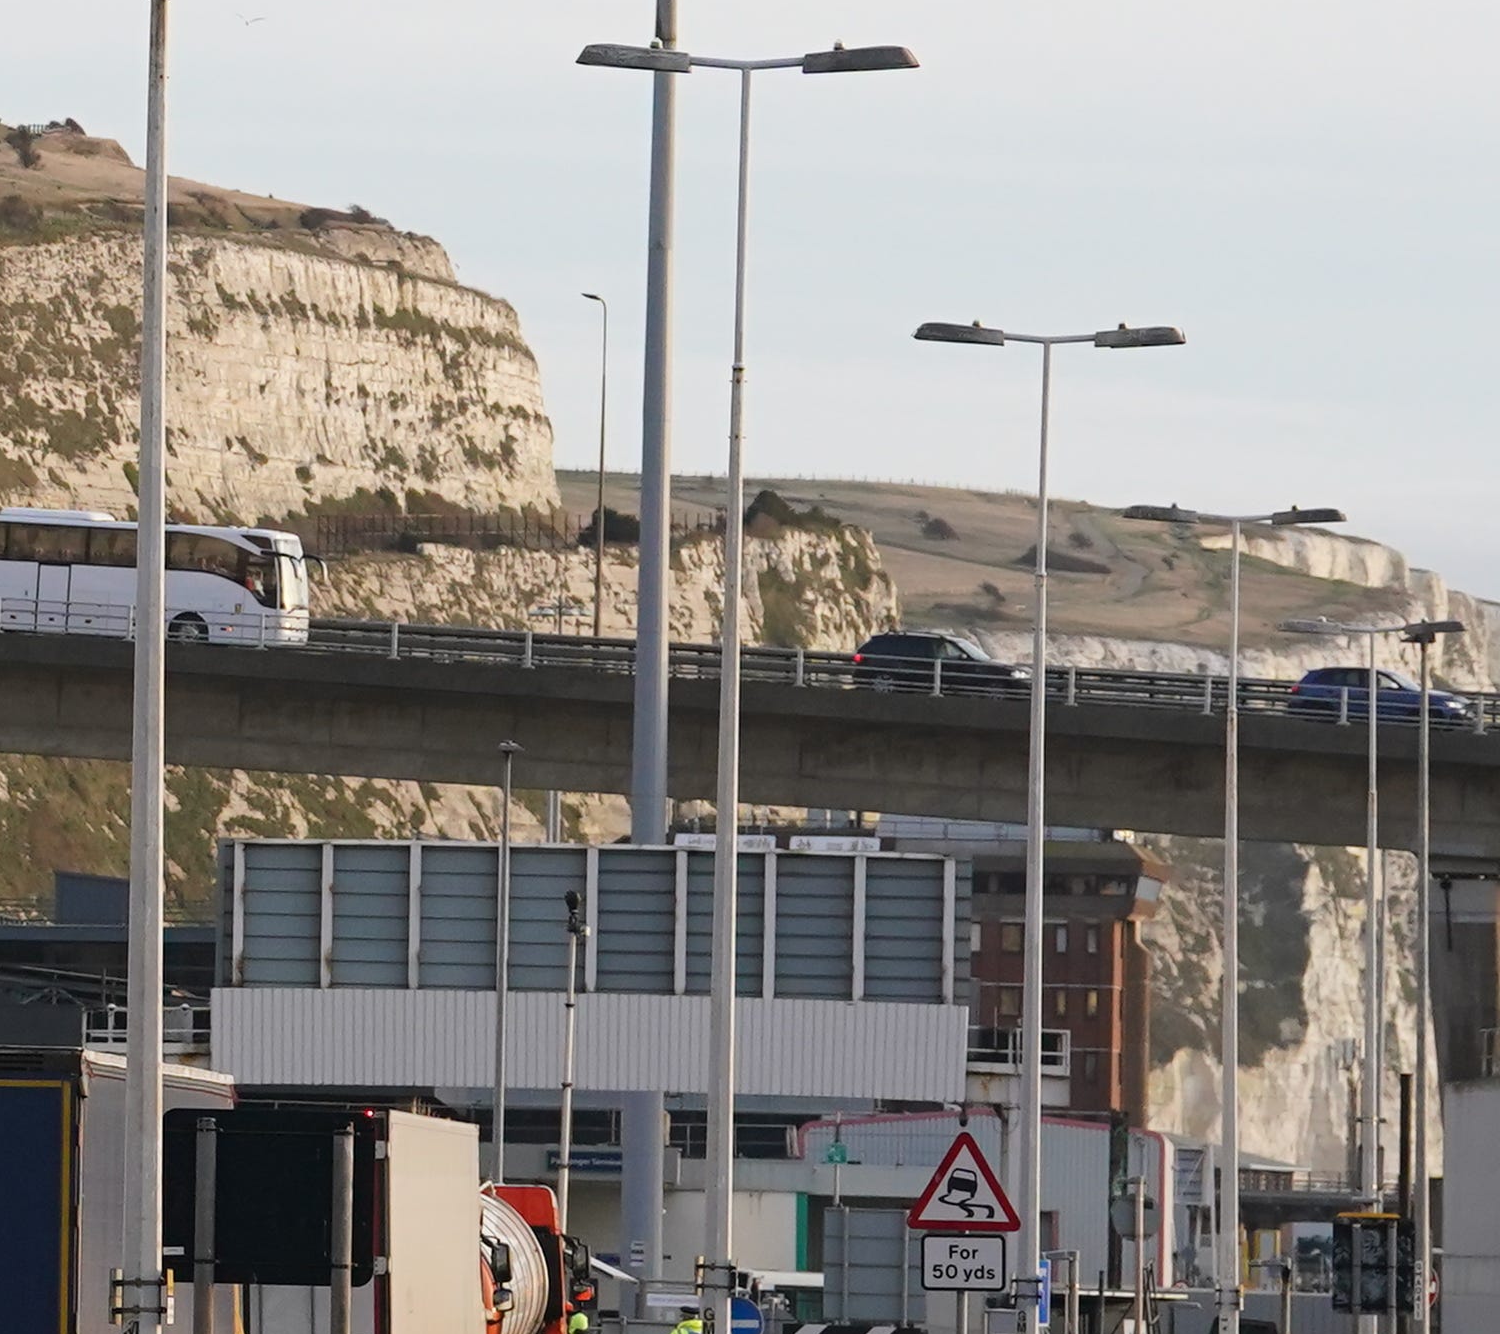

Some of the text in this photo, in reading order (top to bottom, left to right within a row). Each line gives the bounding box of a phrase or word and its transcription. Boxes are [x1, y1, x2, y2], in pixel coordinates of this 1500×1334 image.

[949, 1245, 979, 1259] For
[932, 1264, 995, 1282] 50 yds
